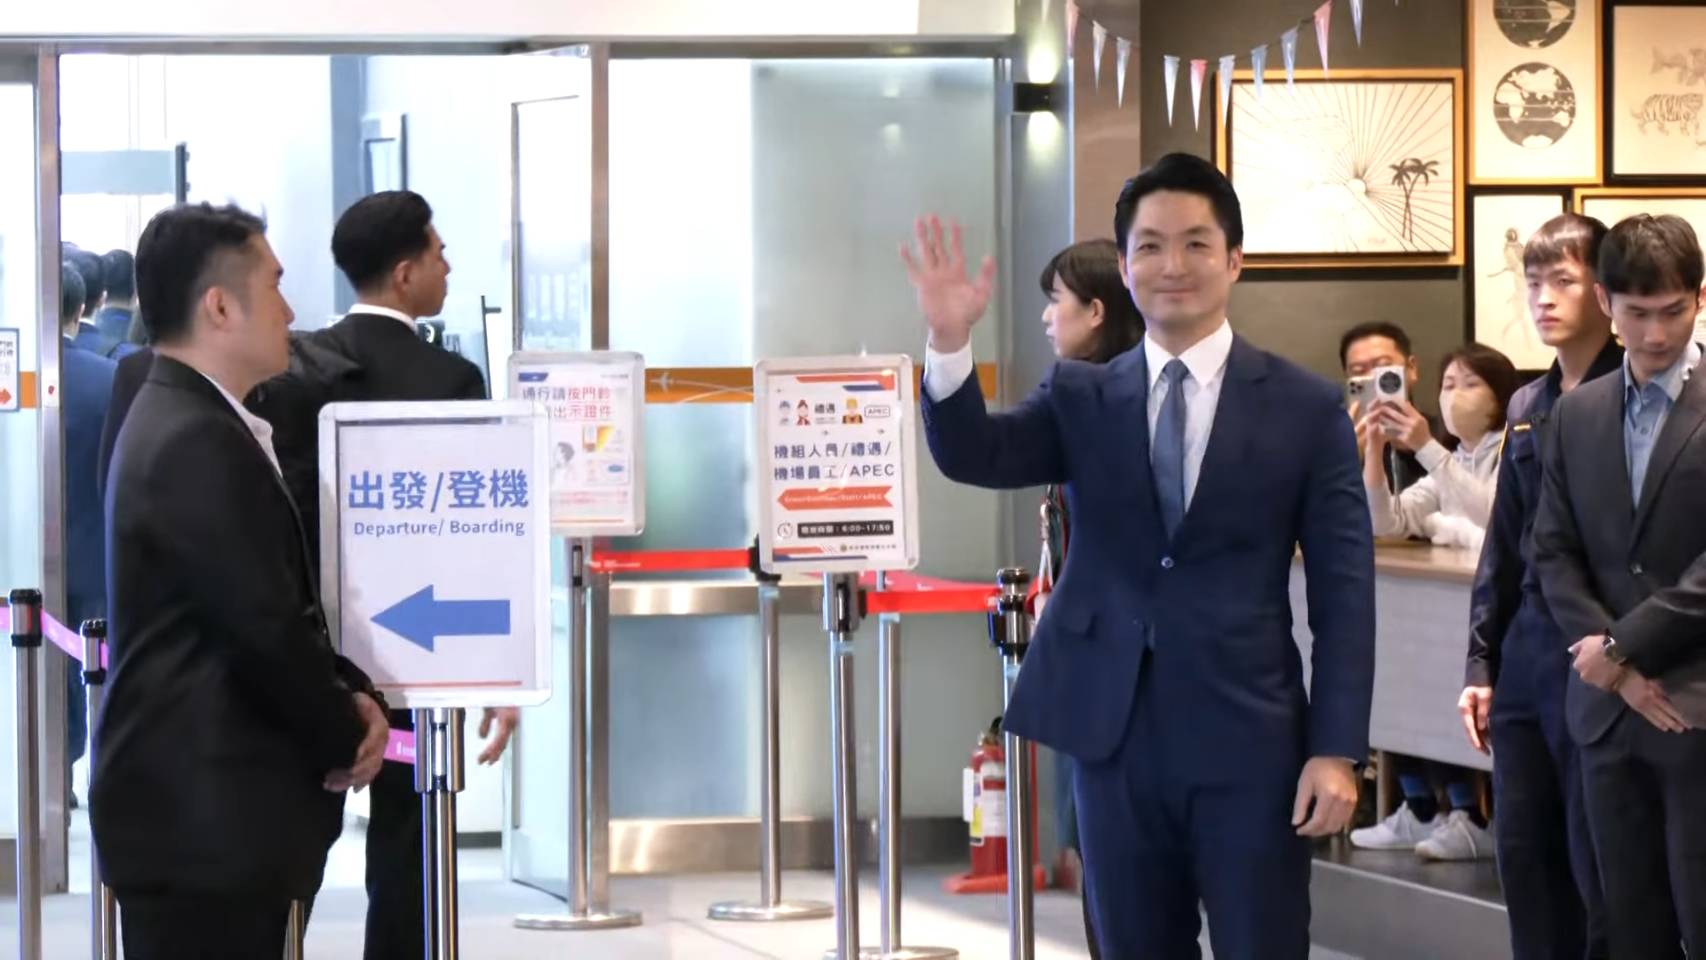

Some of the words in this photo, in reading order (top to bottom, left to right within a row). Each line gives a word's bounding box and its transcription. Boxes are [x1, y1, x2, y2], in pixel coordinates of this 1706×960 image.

[348, 469, 529, 513] 出發/登機
[353, 519, 445, 537] Departure/
[450, 518, 526, 537] Boarding
